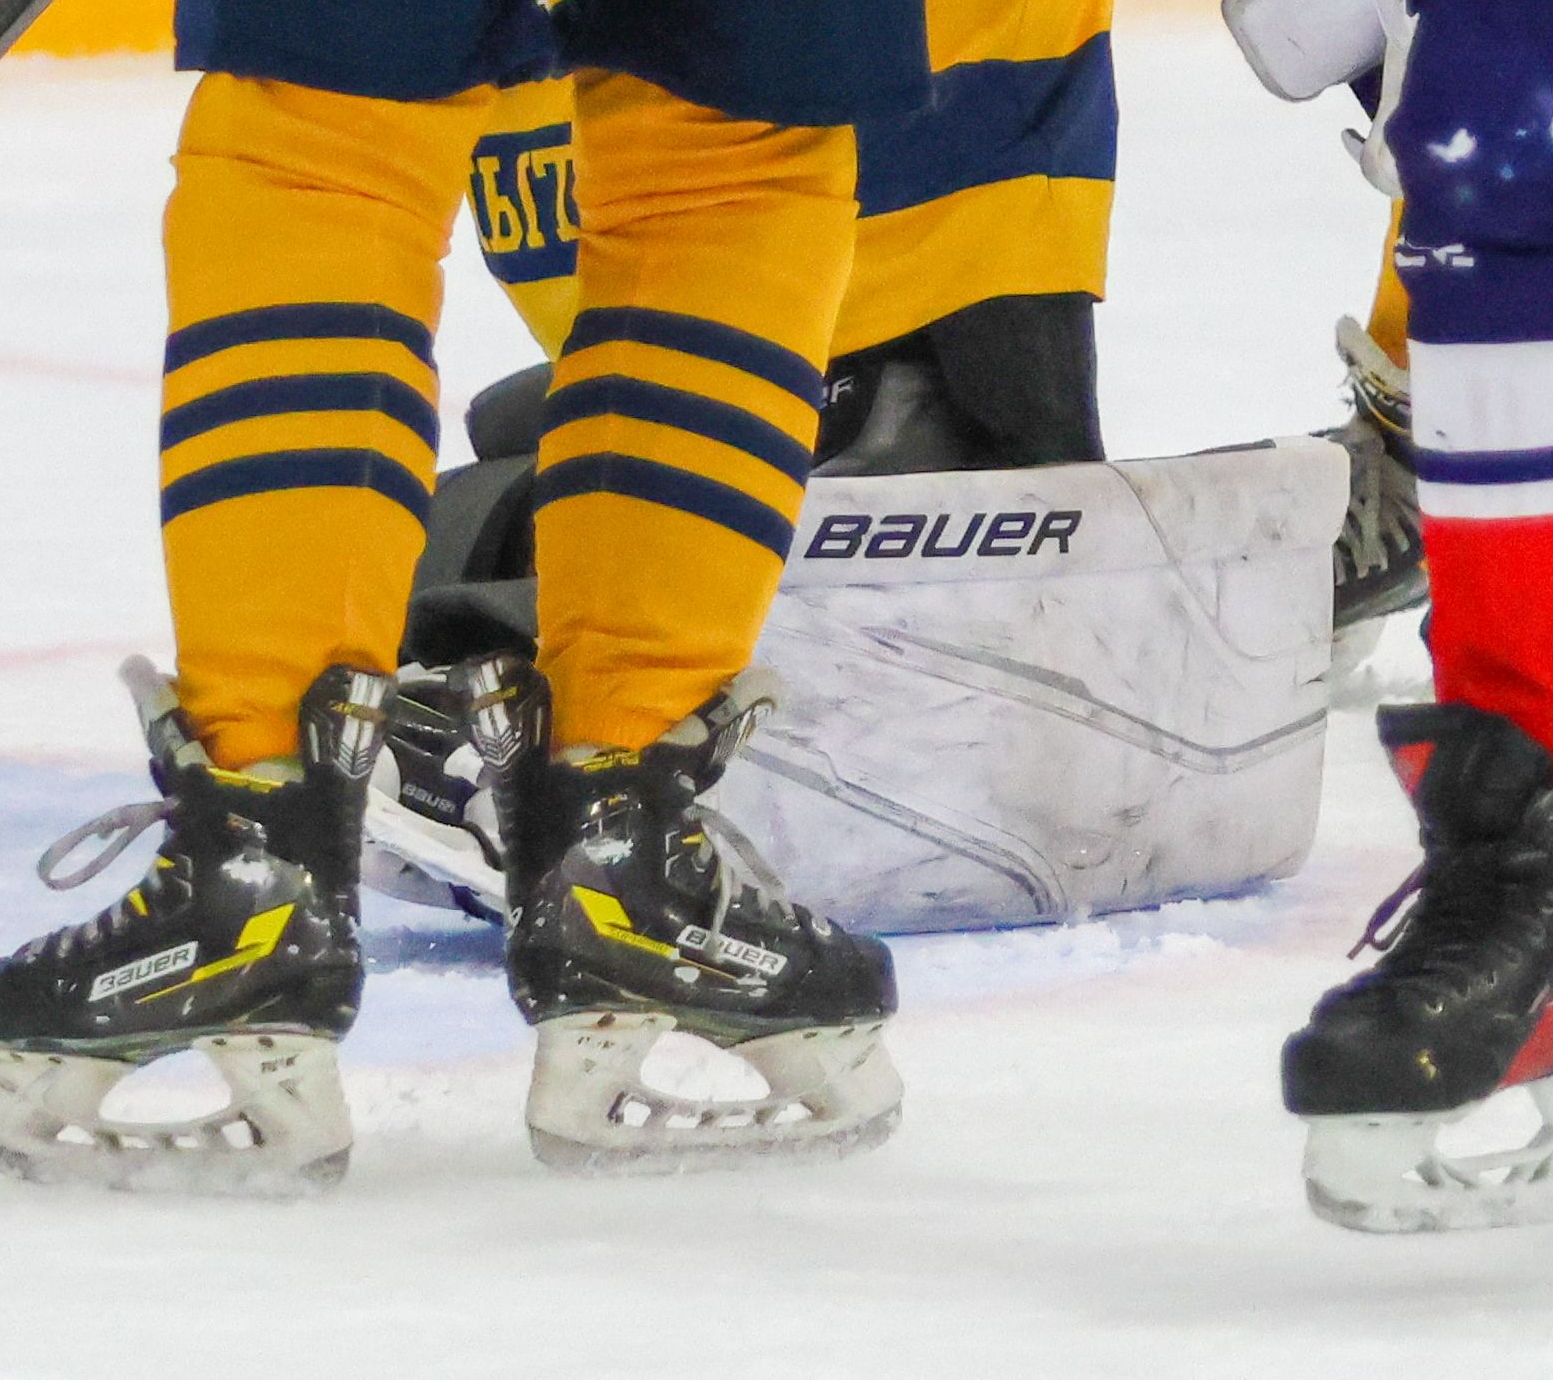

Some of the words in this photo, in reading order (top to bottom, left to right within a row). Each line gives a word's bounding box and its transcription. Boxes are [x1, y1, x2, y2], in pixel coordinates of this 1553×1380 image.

[803, 510, 1083, 559] BAUER
[98, 948, 190, 992] BAUER
[685, 929, 781, 970] BUER
